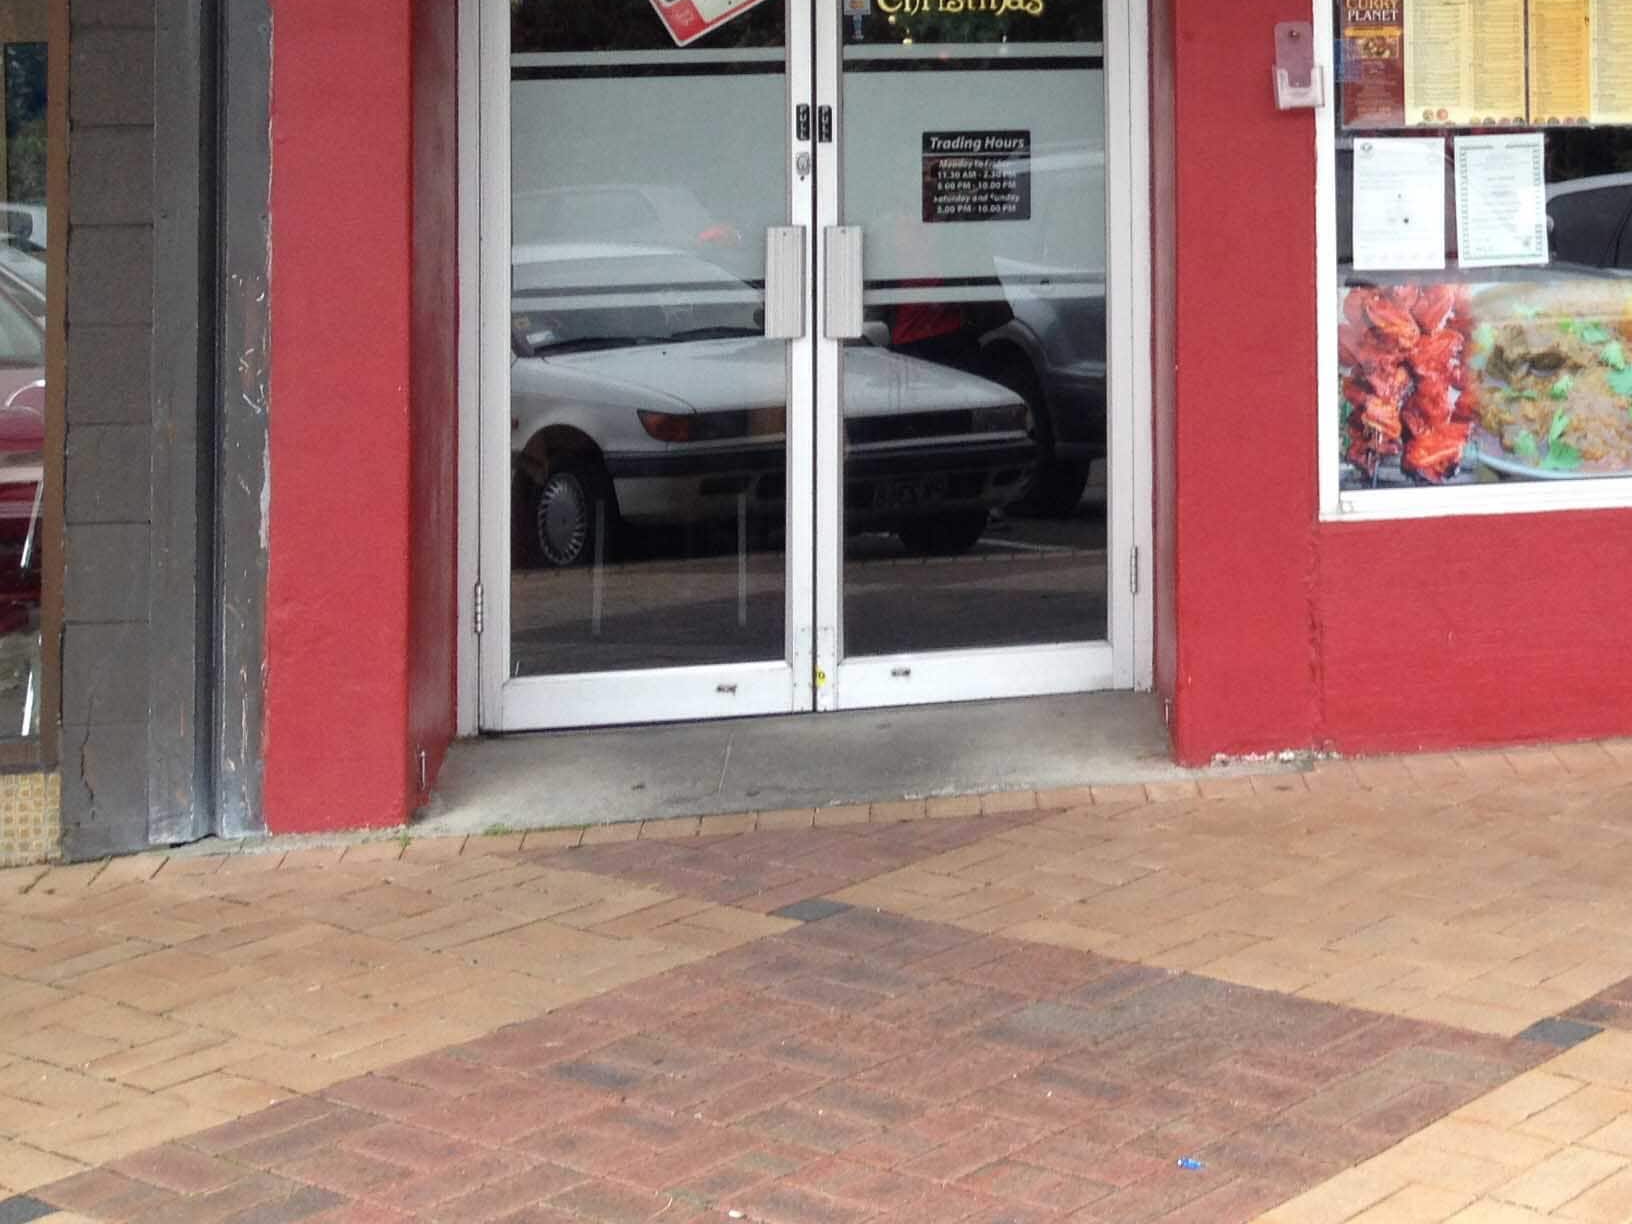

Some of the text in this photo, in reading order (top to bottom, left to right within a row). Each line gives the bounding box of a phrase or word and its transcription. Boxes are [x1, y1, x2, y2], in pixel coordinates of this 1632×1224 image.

[1348, 9, 1399, 22] PLANET
[929, 136, 1026, 153] Trading Hours
